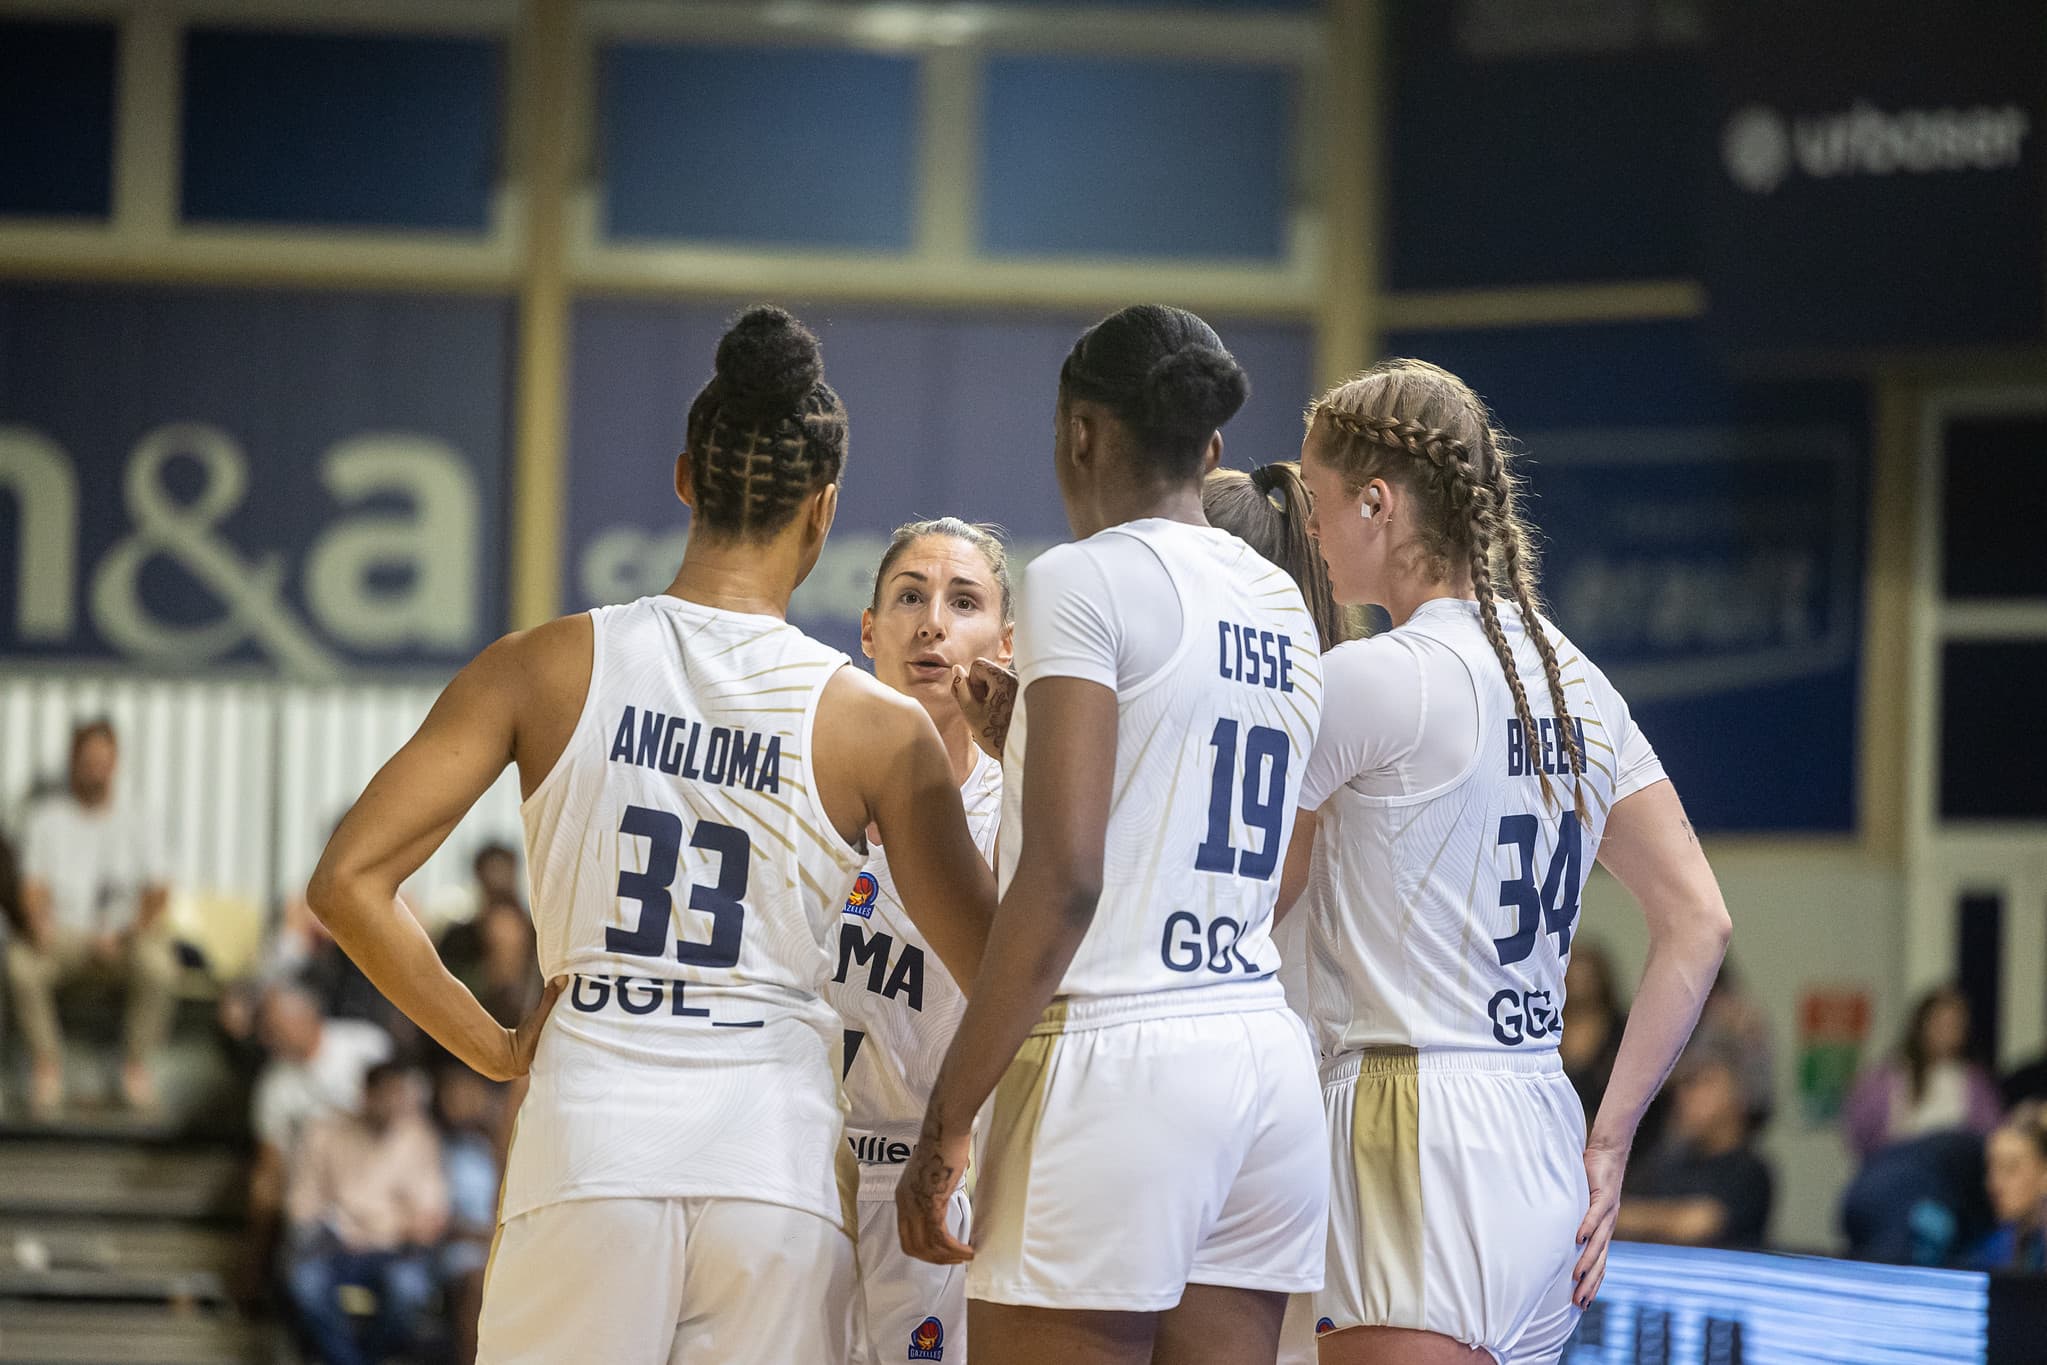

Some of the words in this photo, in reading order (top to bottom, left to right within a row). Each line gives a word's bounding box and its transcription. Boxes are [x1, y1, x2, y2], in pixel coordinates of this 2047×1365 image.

[1217, 620, 1294, 693] CISSE
[609, 705, 781, 794] ANGLOMA
[1195, 717, 1290, 881] 19
[605, 805, 750, 968] 33
[1494, 810, 1582, 966] 34
